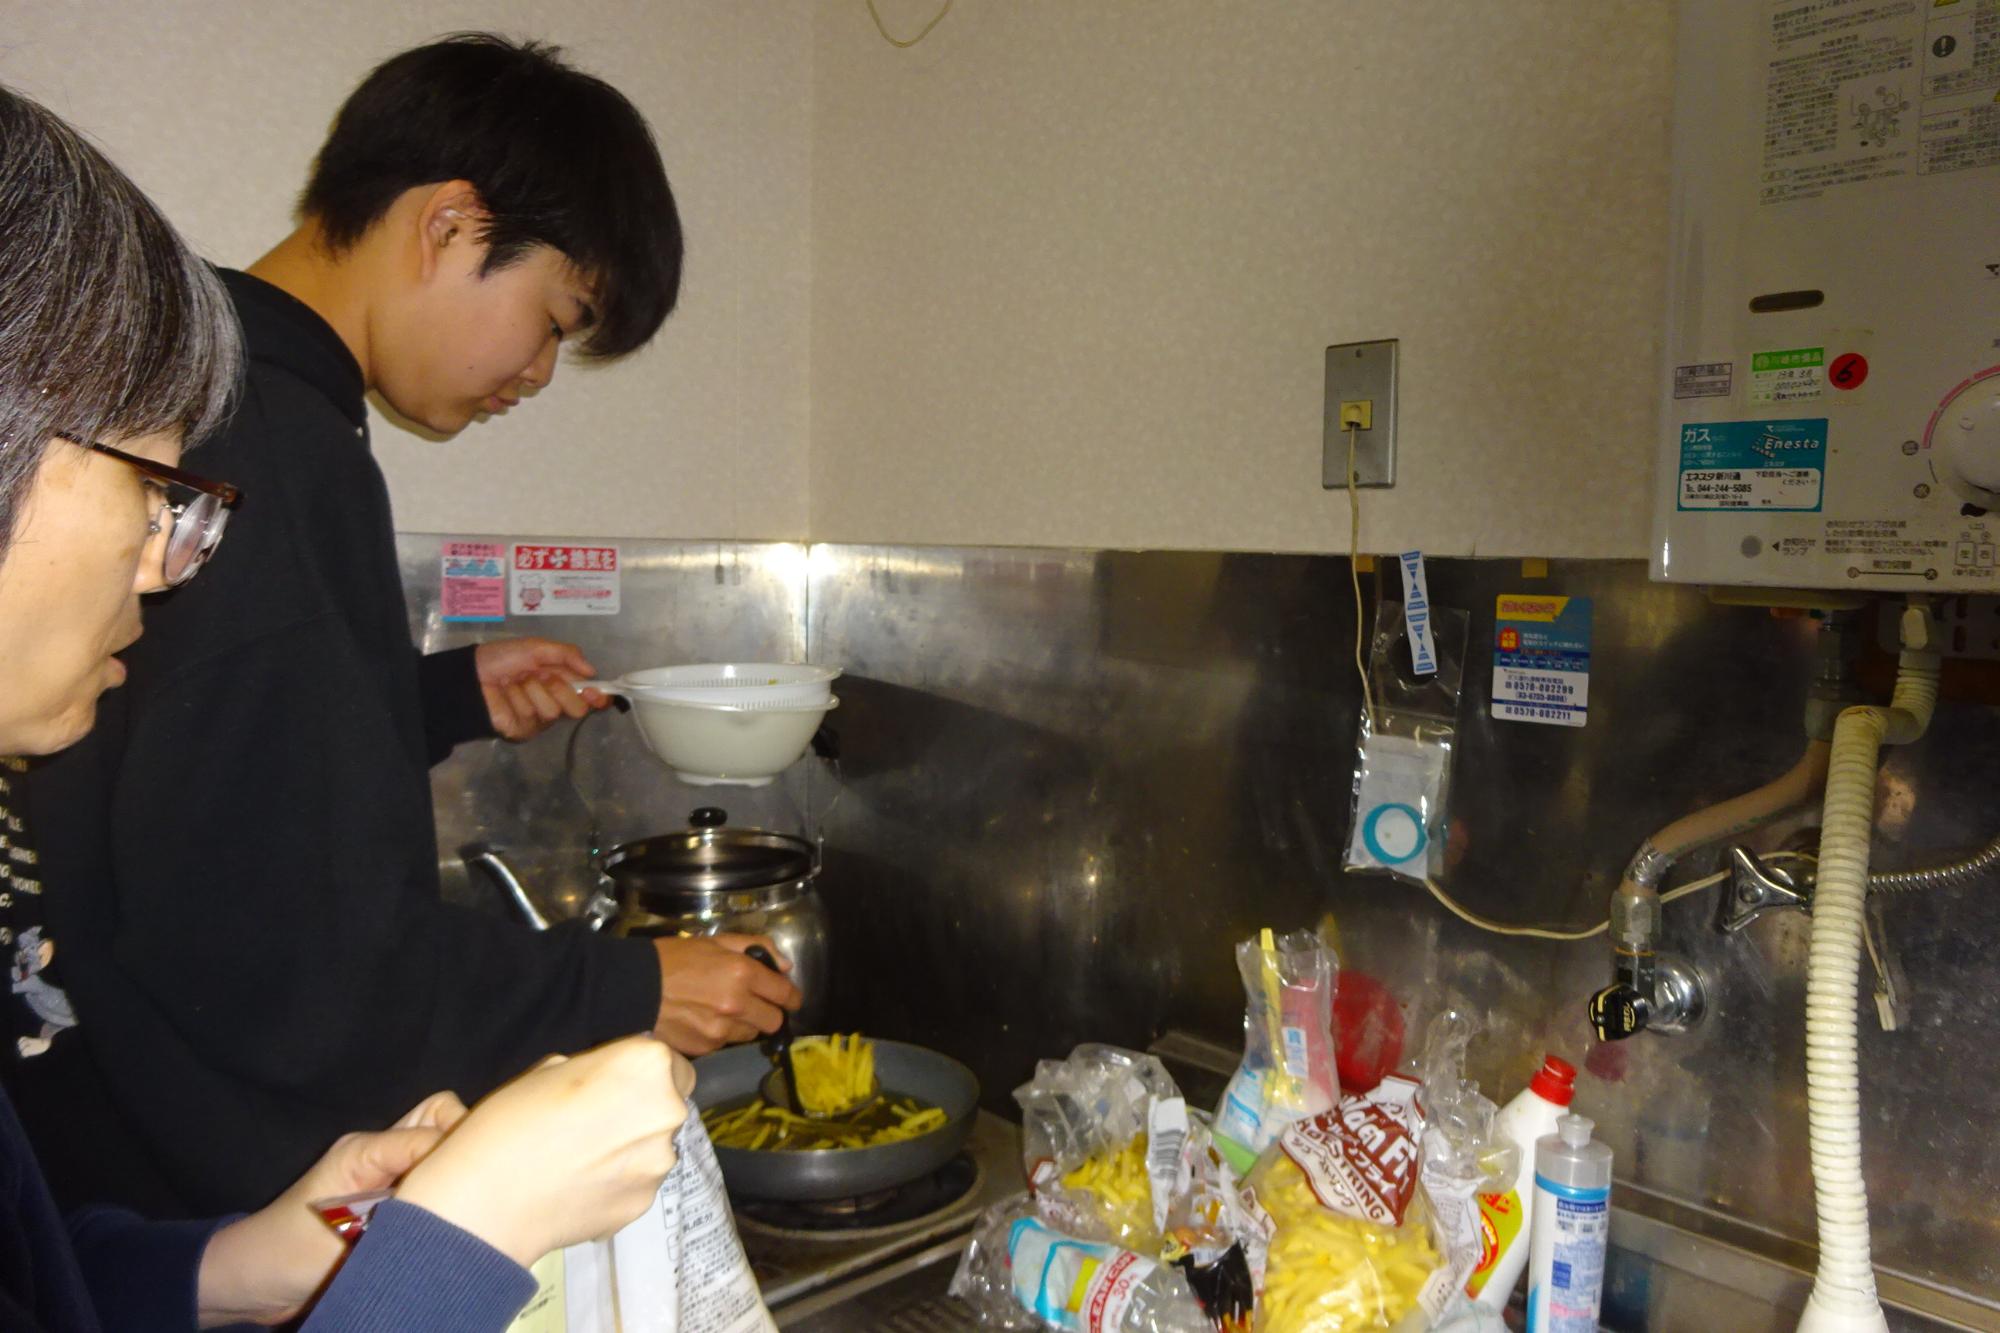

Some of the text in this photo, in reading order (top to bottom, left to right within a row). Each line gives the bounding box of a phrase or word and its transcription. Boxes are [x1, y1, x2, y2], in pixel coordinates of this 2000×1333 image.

[1836, 359, 1857, 383] 6
[1684, 428, 1711, 443] ガス
[1764, 437, 1820, 451] Enesta
